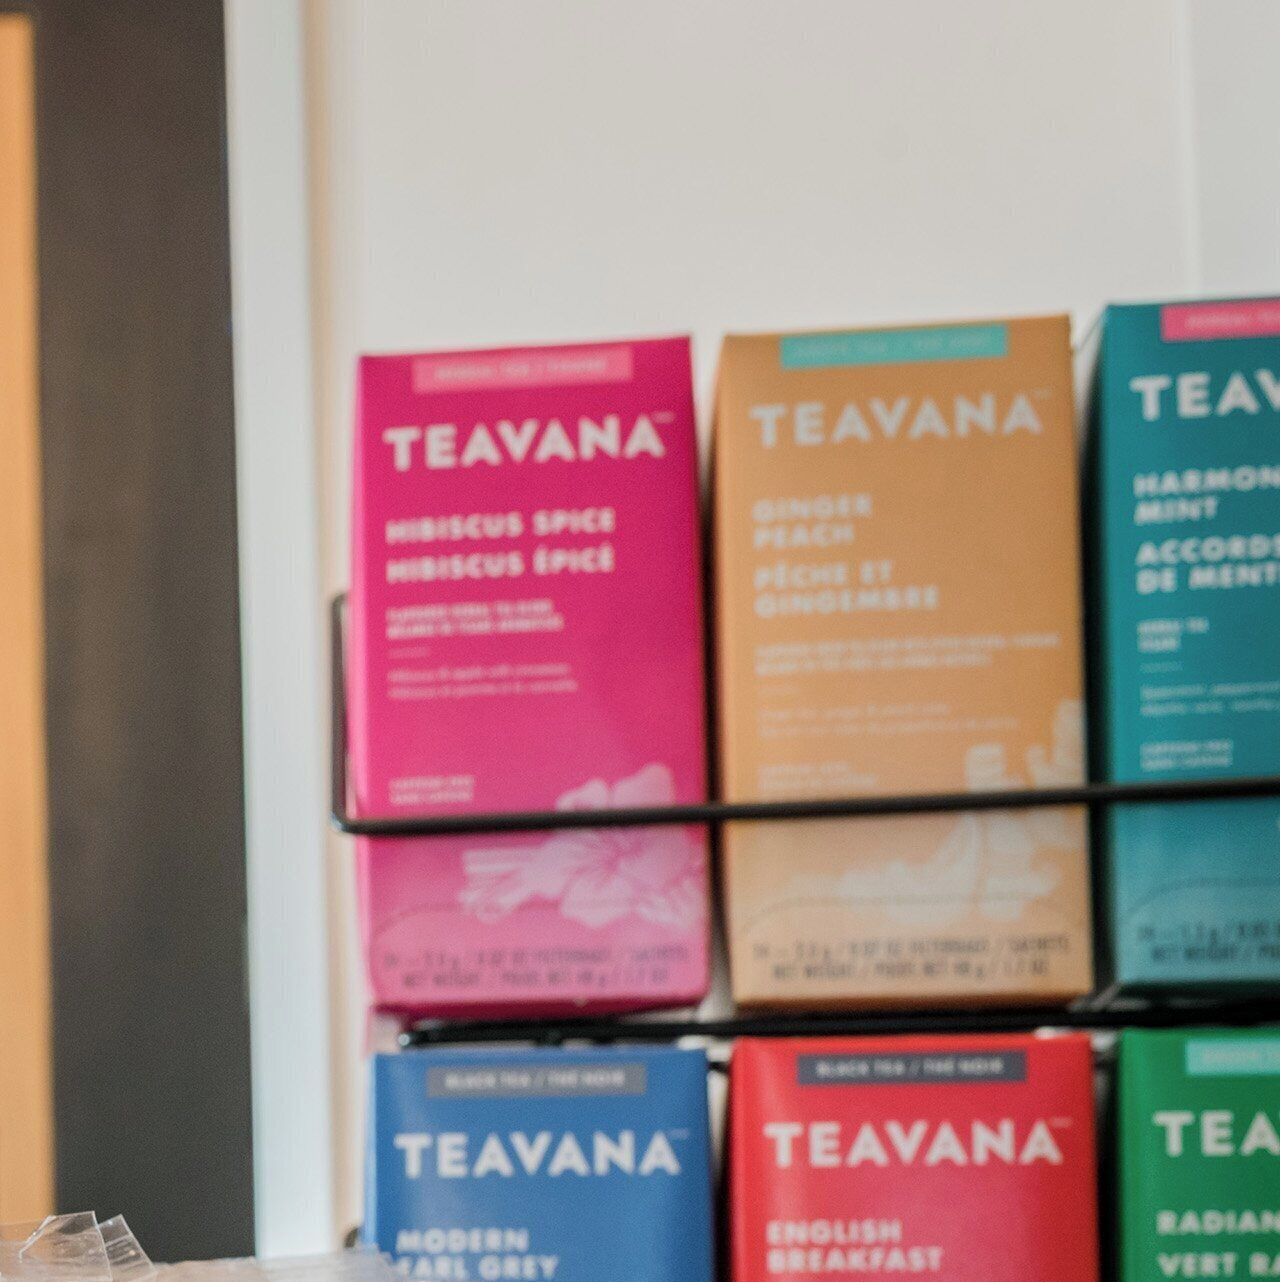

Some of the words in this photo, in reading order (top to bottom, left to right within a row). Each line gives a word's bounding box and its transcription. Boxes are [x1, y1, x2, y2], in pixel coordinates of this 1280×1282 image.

[385, 513, 524, 545] HIBISCUS
[533, 508, 616, 536] SPICE
[386, 551, 525, 584] HIBISCUS
[766, 1218, 904, 1246] ENGLISH
[766, 1246, 944, 1275] BREAKFAST
